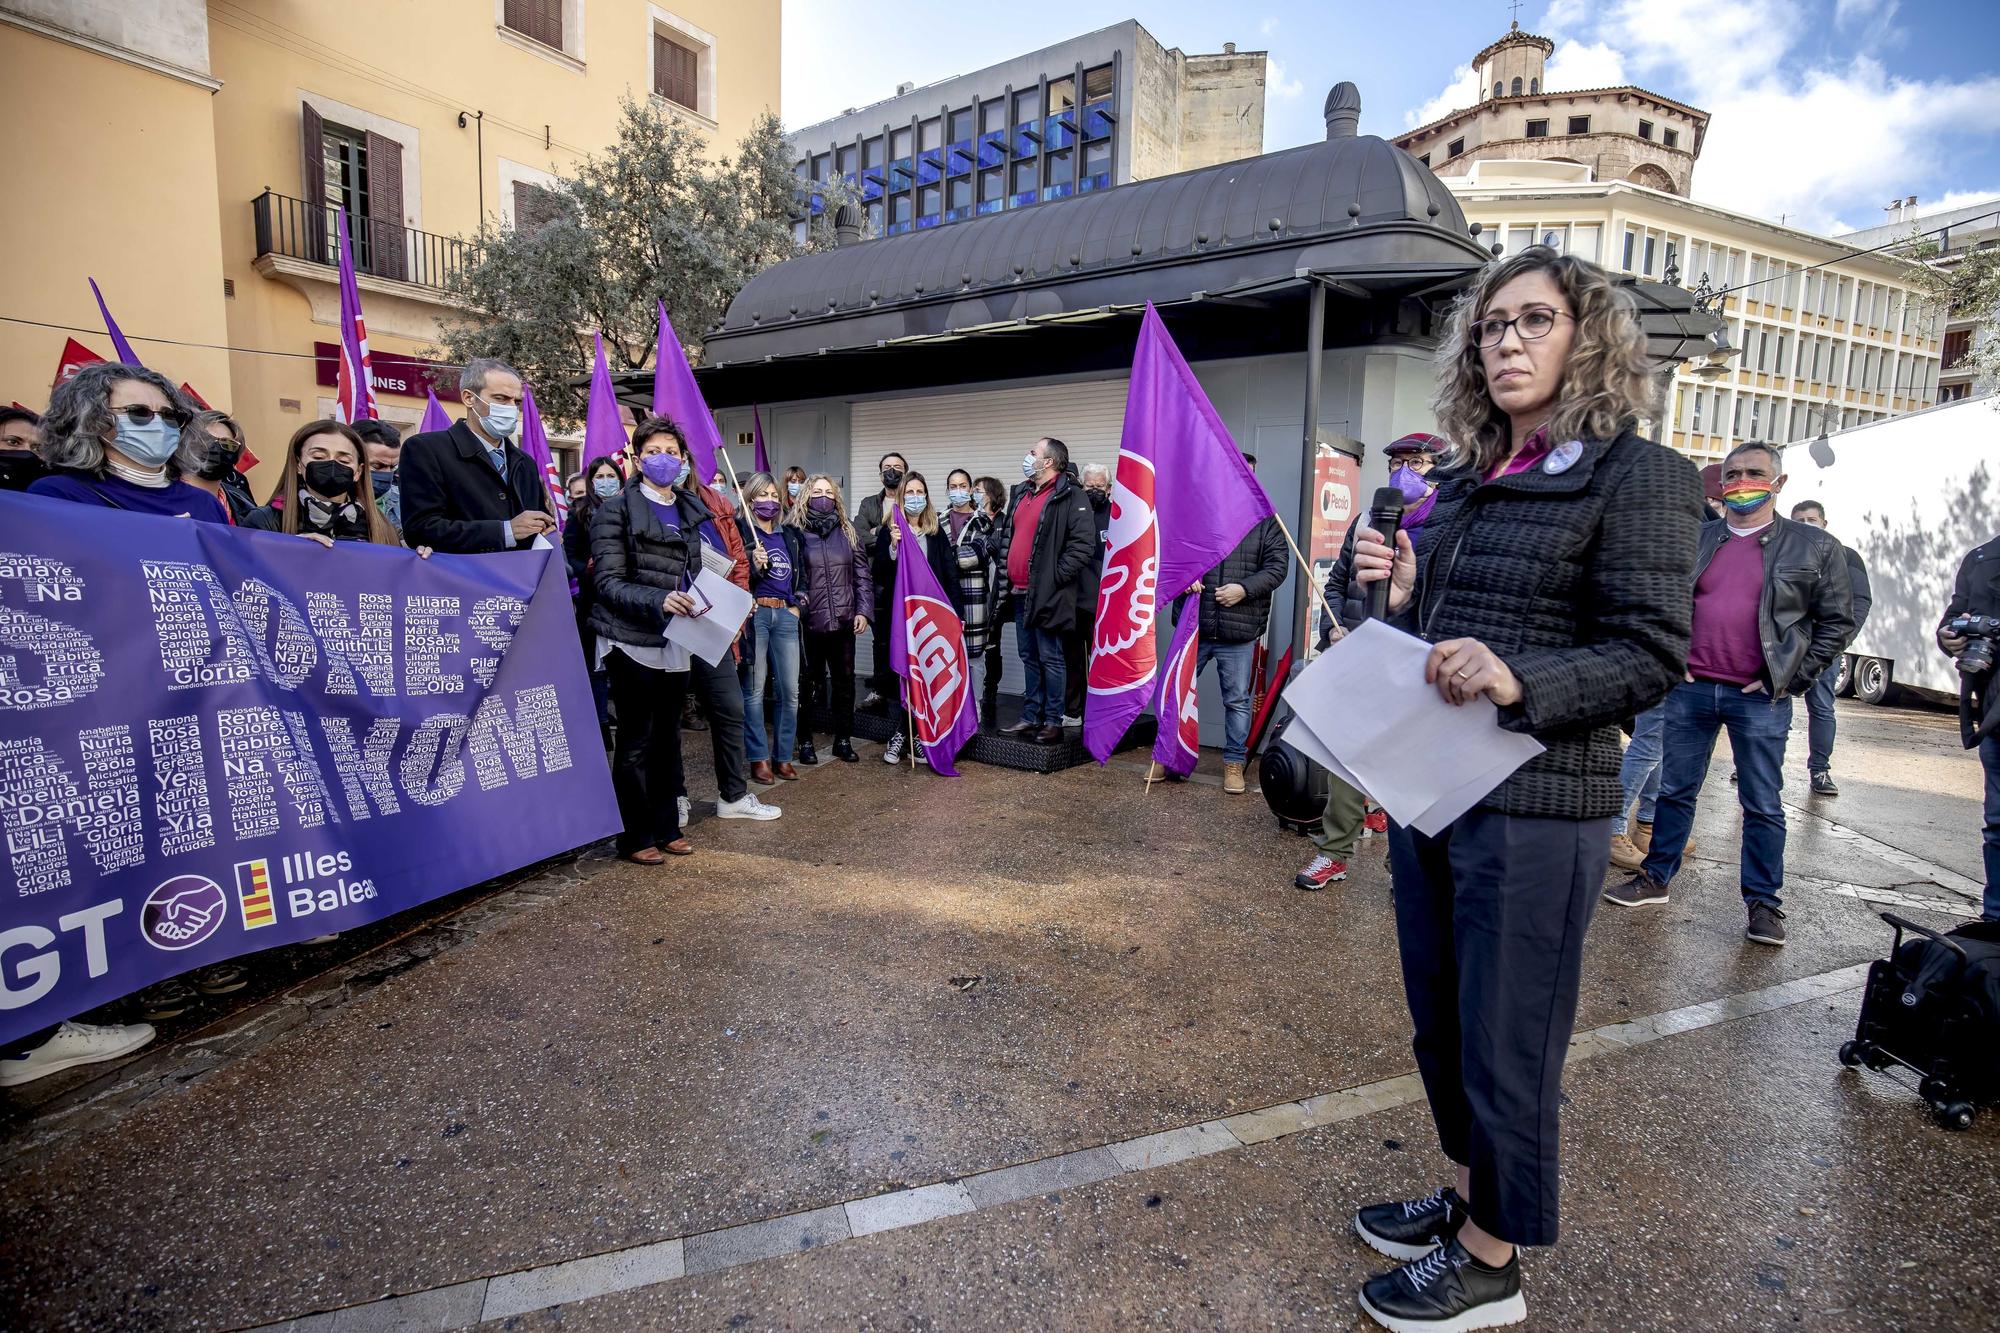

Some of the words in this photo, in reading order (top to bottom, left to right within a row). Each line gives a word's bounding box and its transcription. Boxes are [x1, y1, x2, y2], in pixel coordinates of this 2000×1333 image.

[50, 566, 72, 576] Ye
[142, 564, 213, 582] Mónica
[147, 579, 193, 589] Carmen
[37, 583, 82, 602] Na
[149, 588, 181, 603] Na
[181, 592, 199, 601] Ye
[232, 592, 268, 605] Clara
[305, 591, 337, 600] Paola
[359, 593, 392, 603] Rosa
[152, 602, 203, 613] Mónica
[307, 599, 337, 608] Alina
[359, 602, 392, 610] Renée
[485, 600, 522, 611] Clara
[359, 612, 393, 621] Belén
[404, 606, 460, 615] Concepción
[155, 611, 206, 623] Josefa
[309, 616, 347, 628] Erica
[405, 617, 439, 625] Noelia
[476, 615, 496, 626] Ye
[155, 621, 207, 632] Manuela
[361, 627, 392, 638] Ana
[10, 631, 81, 642] Concepción
[158, 630, 209, 641] Saloua
[313, 627, 352, 639] Miren
[28, 640, 89, 651] Madalina
[160, 638, 211, 649] Carolina
[322, 639, 367, 652] Judith
[405, 634, 445, 646] Rosa
[161, 646, 211, 658] Habibe
[419, 644, 460, 653] Annick
[45, 651, 101, 662] Habibe
[275, 651, 298, 663] Na
[362, 653, 393, 665] Ana
[404, 653, 440, 661] Liliana
[906, 605, 962, 713] UGT
[162, 657, 205, 669] Nuria
[470, 658, 499, 668] Pilar
[46, 663, 101, 676] Erica
[174, 663, 250, 684] Gloria
[279, 664, 309, 675] Olga
[360, 671, 394, 680] Yesica
[405, 666, 441, 675] Gloria
[46, 677, 98, 688] Dolores
[327, 673, 355, 683] Erica
[405, 674, 463, 682] Encarnación
[324, 687, 359, 695] Lorena
[427, 680, 464, 694] Olga
[514, 683, 555, 695] Concepción
[0, 686, 72, 705] Rosa
[516, 690, 557, 704] Lorena
[17, 701, 53, 711] Manoli
[532, 699, 558, 710] Olga
[217, 708, 281, 727] Renée
[525, 708, 560, 720] Manuela
[148, 714, 198, 729] Ramona
[430, 718, 464, 729] Judith
[79, 724, 130, 737] Anabelina
[150, 725, 200, 744] Rosa
[219, 721, 286, 738] Dolores
[370, 730, 398, 738] Ana
[547, 725, 565, 735] Yia
[503, 731, 533, 743] Belén
[80, 736, 132, 751] Nuria
[151, 739, 202, 758] Luisa
[220, 734, 291, 753] Habibe
[405, 744, 438, 753] Paola
[504, 738, 535, 750] Habibe
[82, 746, 134, 760] Daniela
[222, 750, 254, 760] Esther
[272, 749, 297, 759] Olga
[508, 745, 536, 757] Nuria
[153, 755, 203, 772] Teresa
[475, 756, 501, 769] Olga
[512, 752, 536, 763] Rosa
[85, 757, 136, 774] Paola
[223, 757, 265, 777] Na
[476, 763, 505, 776] Manoli
[514, 759, 537, 770] Erica
[89, 771, 118, 781] Alicia
[89, 774, 138, 790] Rosalía
[155, 769, 188, 790] Ye
[189, 778, 207, 787] Na
[228, 778, 269, 790] Saloua
[400, 778, 428, 790] Luisa
[0, 785, 78, 809] Noelia
[155, 784, 208, 803] Karina
[228, 785, 275, 799] Noelia
[419, 787, 454, 802] Gloria
[230, 793, 271, 806] Josefa
[19, 789, 141, 825] Daniela
[156, 796, 210, 817] Nuria
[295, 801, 323, 815] Yia
[3, 812, 18, 821] Ye
[76, 806, 141, 831] Paola
[231, 807, 277, 821] Habibe
[298, 811, 325, 825] Pilar
[3, 820, 20, 829] Na
[166, 813, 213, 834] Yia
[233, 815, 280, 832] Luisa
[87, 820, 143, 843] Gloria
[161, 827, 214, 847] Annick
[90, 832, 144, 855] Judith
[161, 839, 216, 857] Virtudes
[11, 845, 67, 866] Manoli
[95, 845, 144, 866] Lillemor
[102, 853, 145, 871] Yolanda
[282, 851, 353, 884] Illes
[15, 860, 69, 877] Virtudes
[17, 868, 70, 888] Gloria
[19, 878, 72, 897] Susana
